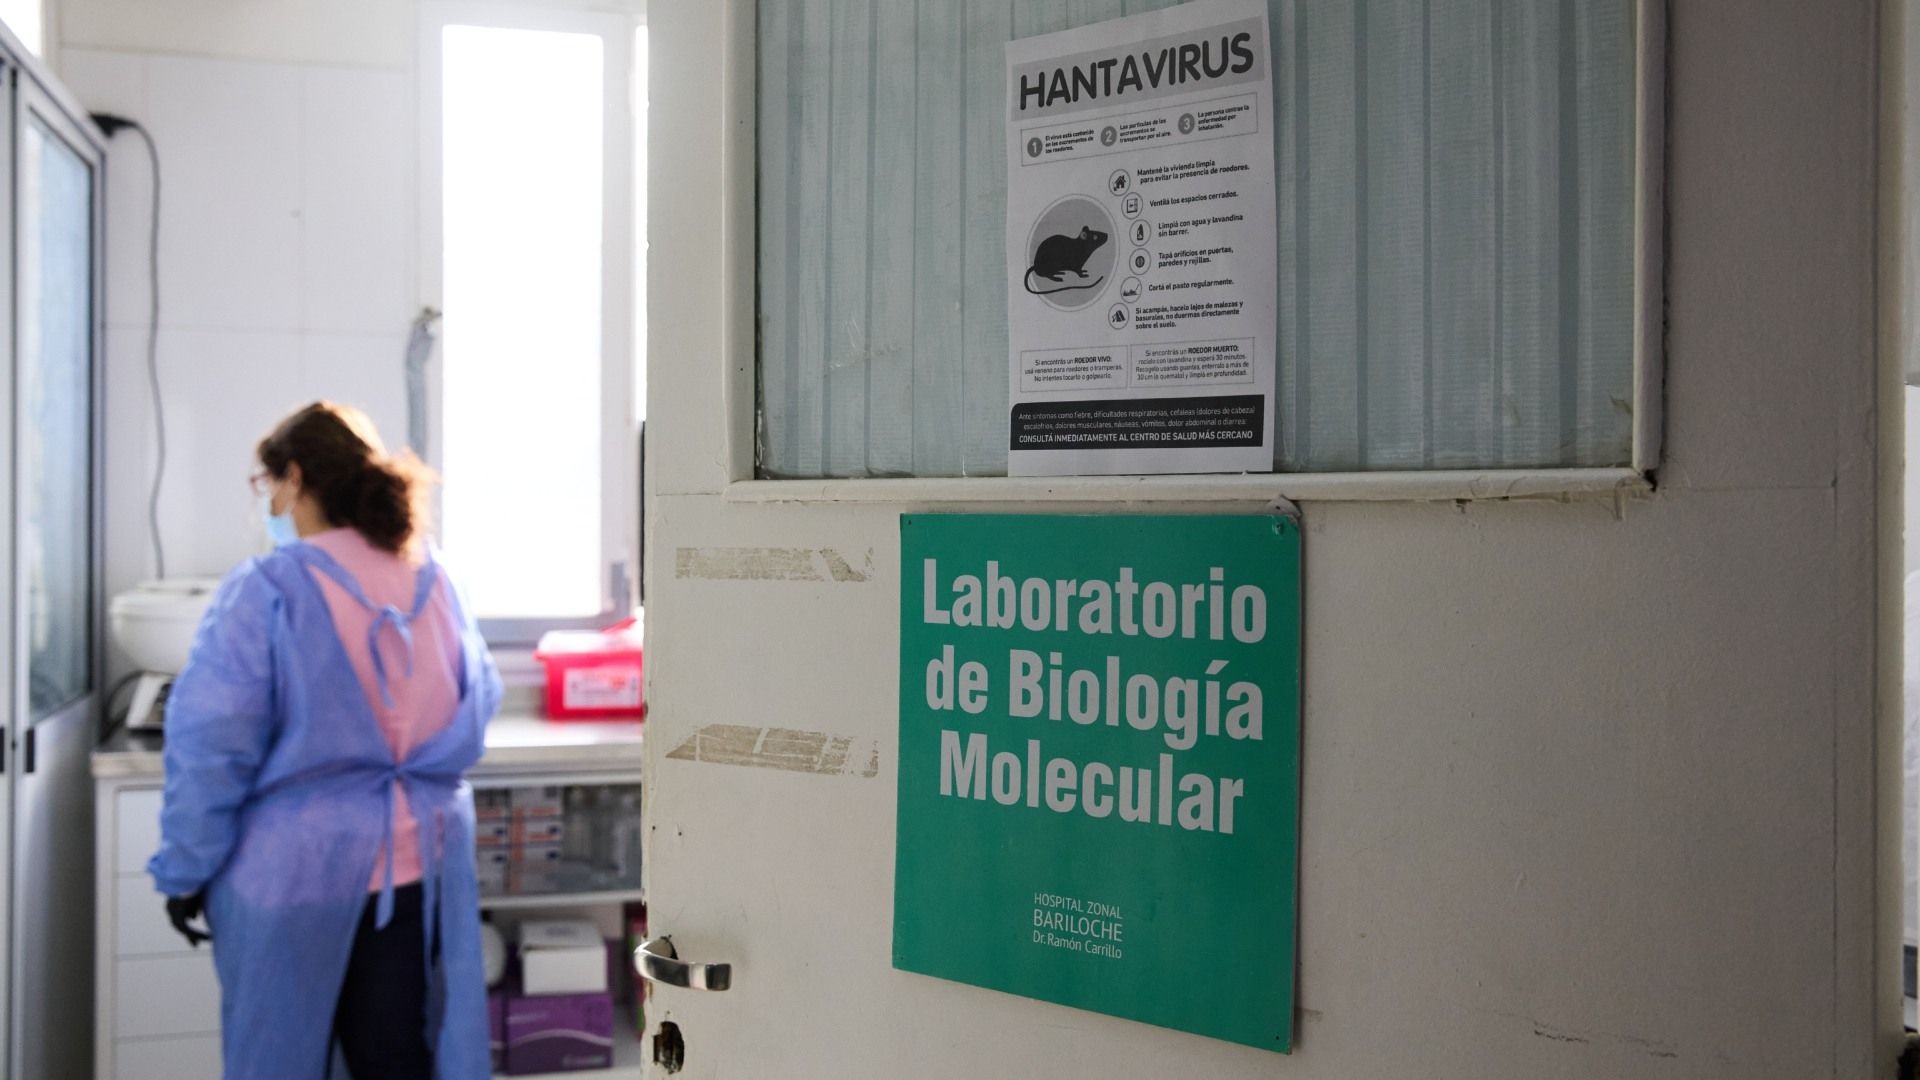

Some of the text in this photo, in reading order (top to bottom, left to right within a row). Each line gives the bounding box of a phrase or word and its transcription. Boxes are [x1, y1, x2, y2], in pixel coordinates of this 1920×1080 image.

[1020, 32, 1254, 110] HANTAVIRUS
[1184, 118, 1190, 130] 3
[1106, 130, 1112, 142] 2
[1033, 142, 1036, 152] 1
[1138, 167, 1162, 176] Mantené
[1170, 163, 1195, 171] vivienda
[1180, 169, 1209, 178] presencia
[1220, 164, 1250, 173] roedores.
[1181, 195, 1207, 204] espacios
[1209, 190, 1238, 199] cerrados.
[1212, 214, 1243, 223] lavandina
[1159, 251, 1173, 260] Tapá
[1208, 247, 1233, 255] puertas,
[1159, 260, 1182, 268] paredes
[1189, 257, 1211, 266] rejillas.
[1173, 282, 1190, 290] pasto
[1191, 278, 1234, 288] regularmente.
[1201, 309, 1239, 317] directamente
[1129, 408, 1168, 417] respiratorias,
[1020, 432, 1053, 443] CONSULTÁ
[1055, 434, 1117, 442] INMEDIATAMENTE
[1130, 432, 1159, 440] CENTRO
[1172, 432, 1197, 440] SALUD
[1199, 429, 1215, 440] MÁS
[1216, 431, 1252, 439] CERCANO
[924, 558, 1266, 644] Laboratorio
[926, 645, 1263, 750] de Biología
[940, 729, 1243, 834] Molecular
[1035, 892, 1123, 919] HOSPITAL ZONAL
[1034, 909, 1122, 942] BARILOCHE
[1033, 930, 1122, 958] Dr. Ramón Carrillo
